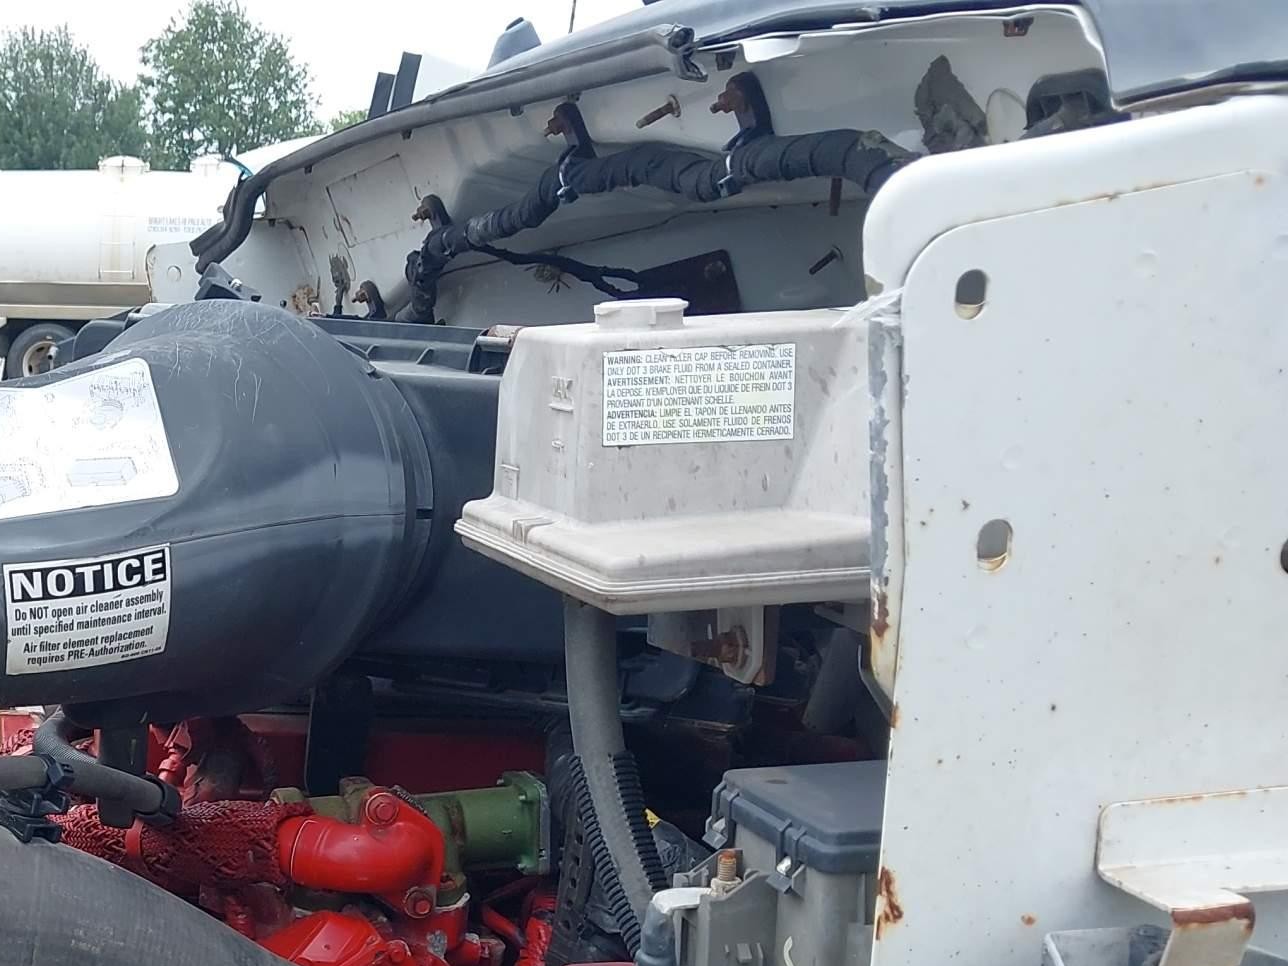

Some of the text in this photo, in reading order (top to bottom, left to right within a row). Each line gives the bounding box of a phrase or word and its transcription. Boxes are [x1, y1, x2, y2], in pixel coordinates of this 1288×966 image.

[608, 355, 642, 365] WARNING:
[646, 354, 668, 363] CLEAN
[695, 352, 708, 361] CAP
[711, 351, 737, 360] BEFORE
[780, 348, 793, 358] USE
[608, 367, 624, 376] ONLY
[627, 366, 640, 375] DOT
[642, 366, 647, 374] 3
[650, 365, 672, 374] BRAKE
[674, 364, 693, 373] FLUID
[696, 363, 715, 372] FROM
[717, 362, 722, 371] A
[724, 361, 750, 370] SEALED
[607, 370, 792, 386] AVERTISSEMENT: NETTOYER LE BOUCHON AVANT
[607, 389, 616, 398] LA
[646, 386, 686, 396] N'EMPLOYER
[688, 385, 702, 394] QUE
[703, 384, 712, 394] DU
[714, 383, 739, 393] LIQUIDE
[741, 383, 750, 392] DE
[752, 382, 770, 392] FREIN
[772, 382, 786, 391] DOT
[788, 381, 793, 391] 3
[607, 399, 645, 408] PROVENANT
[647, 398, 662, 407] D'UN
[664, 396, 703, 406] CONTENANT
[607, 409, 657, 419] ADVERTENCIA:
[660, 408, 682, 418] LIMPIE
[684, 408, 691, 416] EL
[719, 406, 728, 415] DE
[731, 405, 767, 414] LLENANDO
[769, 403, 791, 413] ANTES
[607, 421, 616, 431] DE
[663, 419, 676, 428] USE
[679, 418, 721, 428] SOLAMENTE
[724, 416, 748, 426] FLUIDO
[752, 416, 760, 425] DE
[764, 415, 791, 425] FRENOS
[607, 426, 791, 441] DOT 3 DE UN RECIPIENTE HERMETICAMENTE CERRADO.
[12, 552, 165, 600] NOTICE
[15, 588, 164, 621] Do NOT open air cleaner assembly
[12, 602, 166, 637] until specified maintenance interval.
[24, 625, 153, 653] Air filter element replacement
[27, 653, 65, 666] requires
[68, 640, 147, 661] PRE-Authorization.
